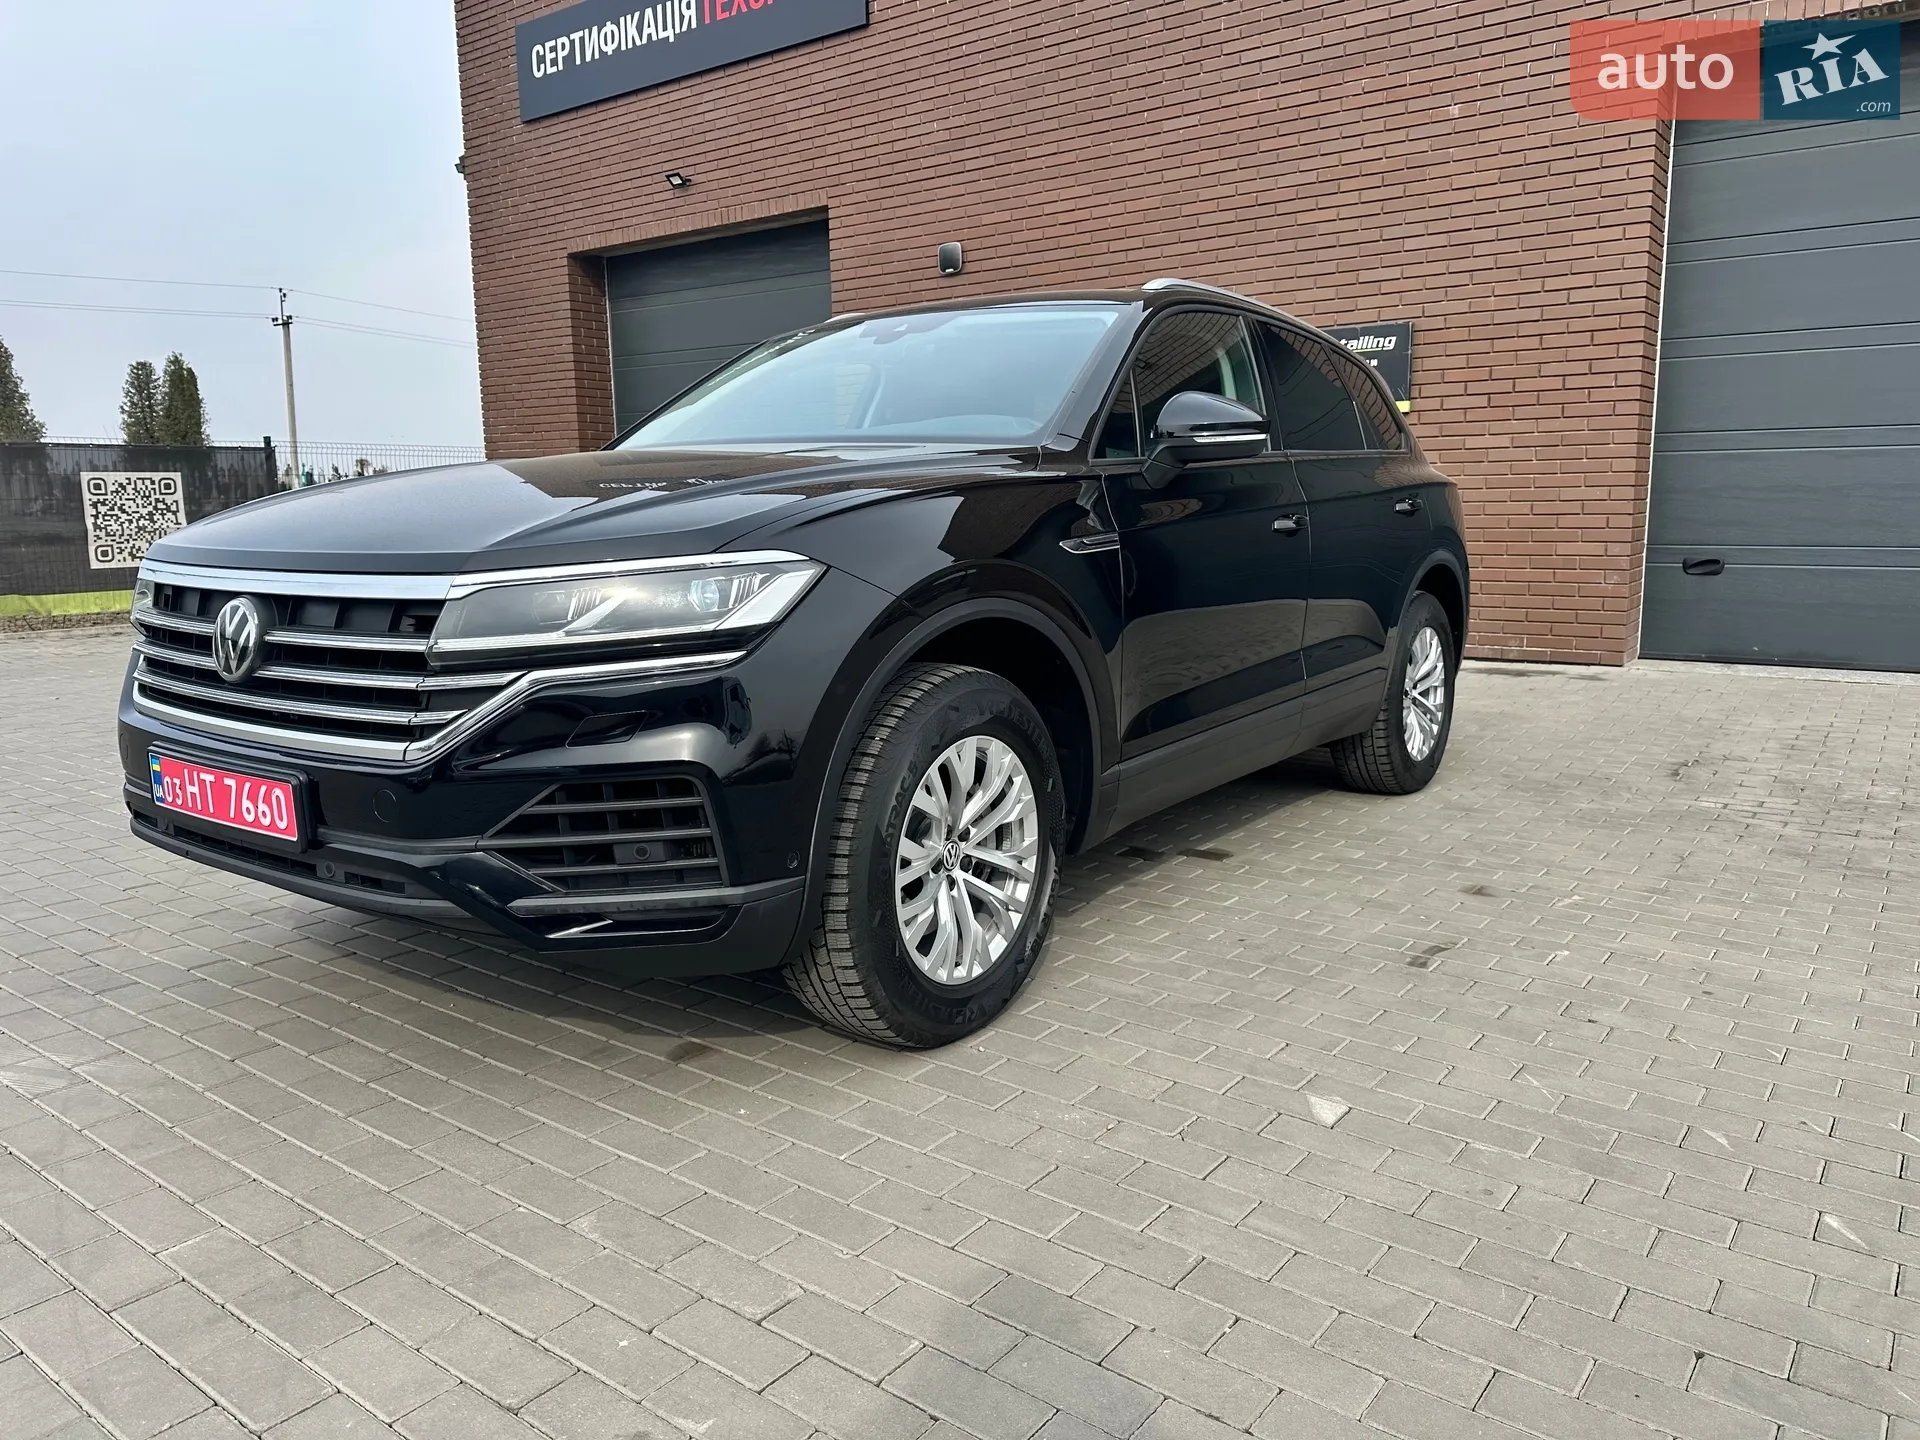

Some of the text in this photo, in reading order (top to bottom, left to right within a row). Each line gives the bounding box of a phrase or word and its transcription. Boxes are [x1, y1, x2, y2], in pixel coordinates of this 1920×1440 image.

[531, 0, 697, 79] СЕРТИФІКАЦІЯ
[154, 783, 164, 798] UA
[163, 768, 288, 830] 03 HT 7660
